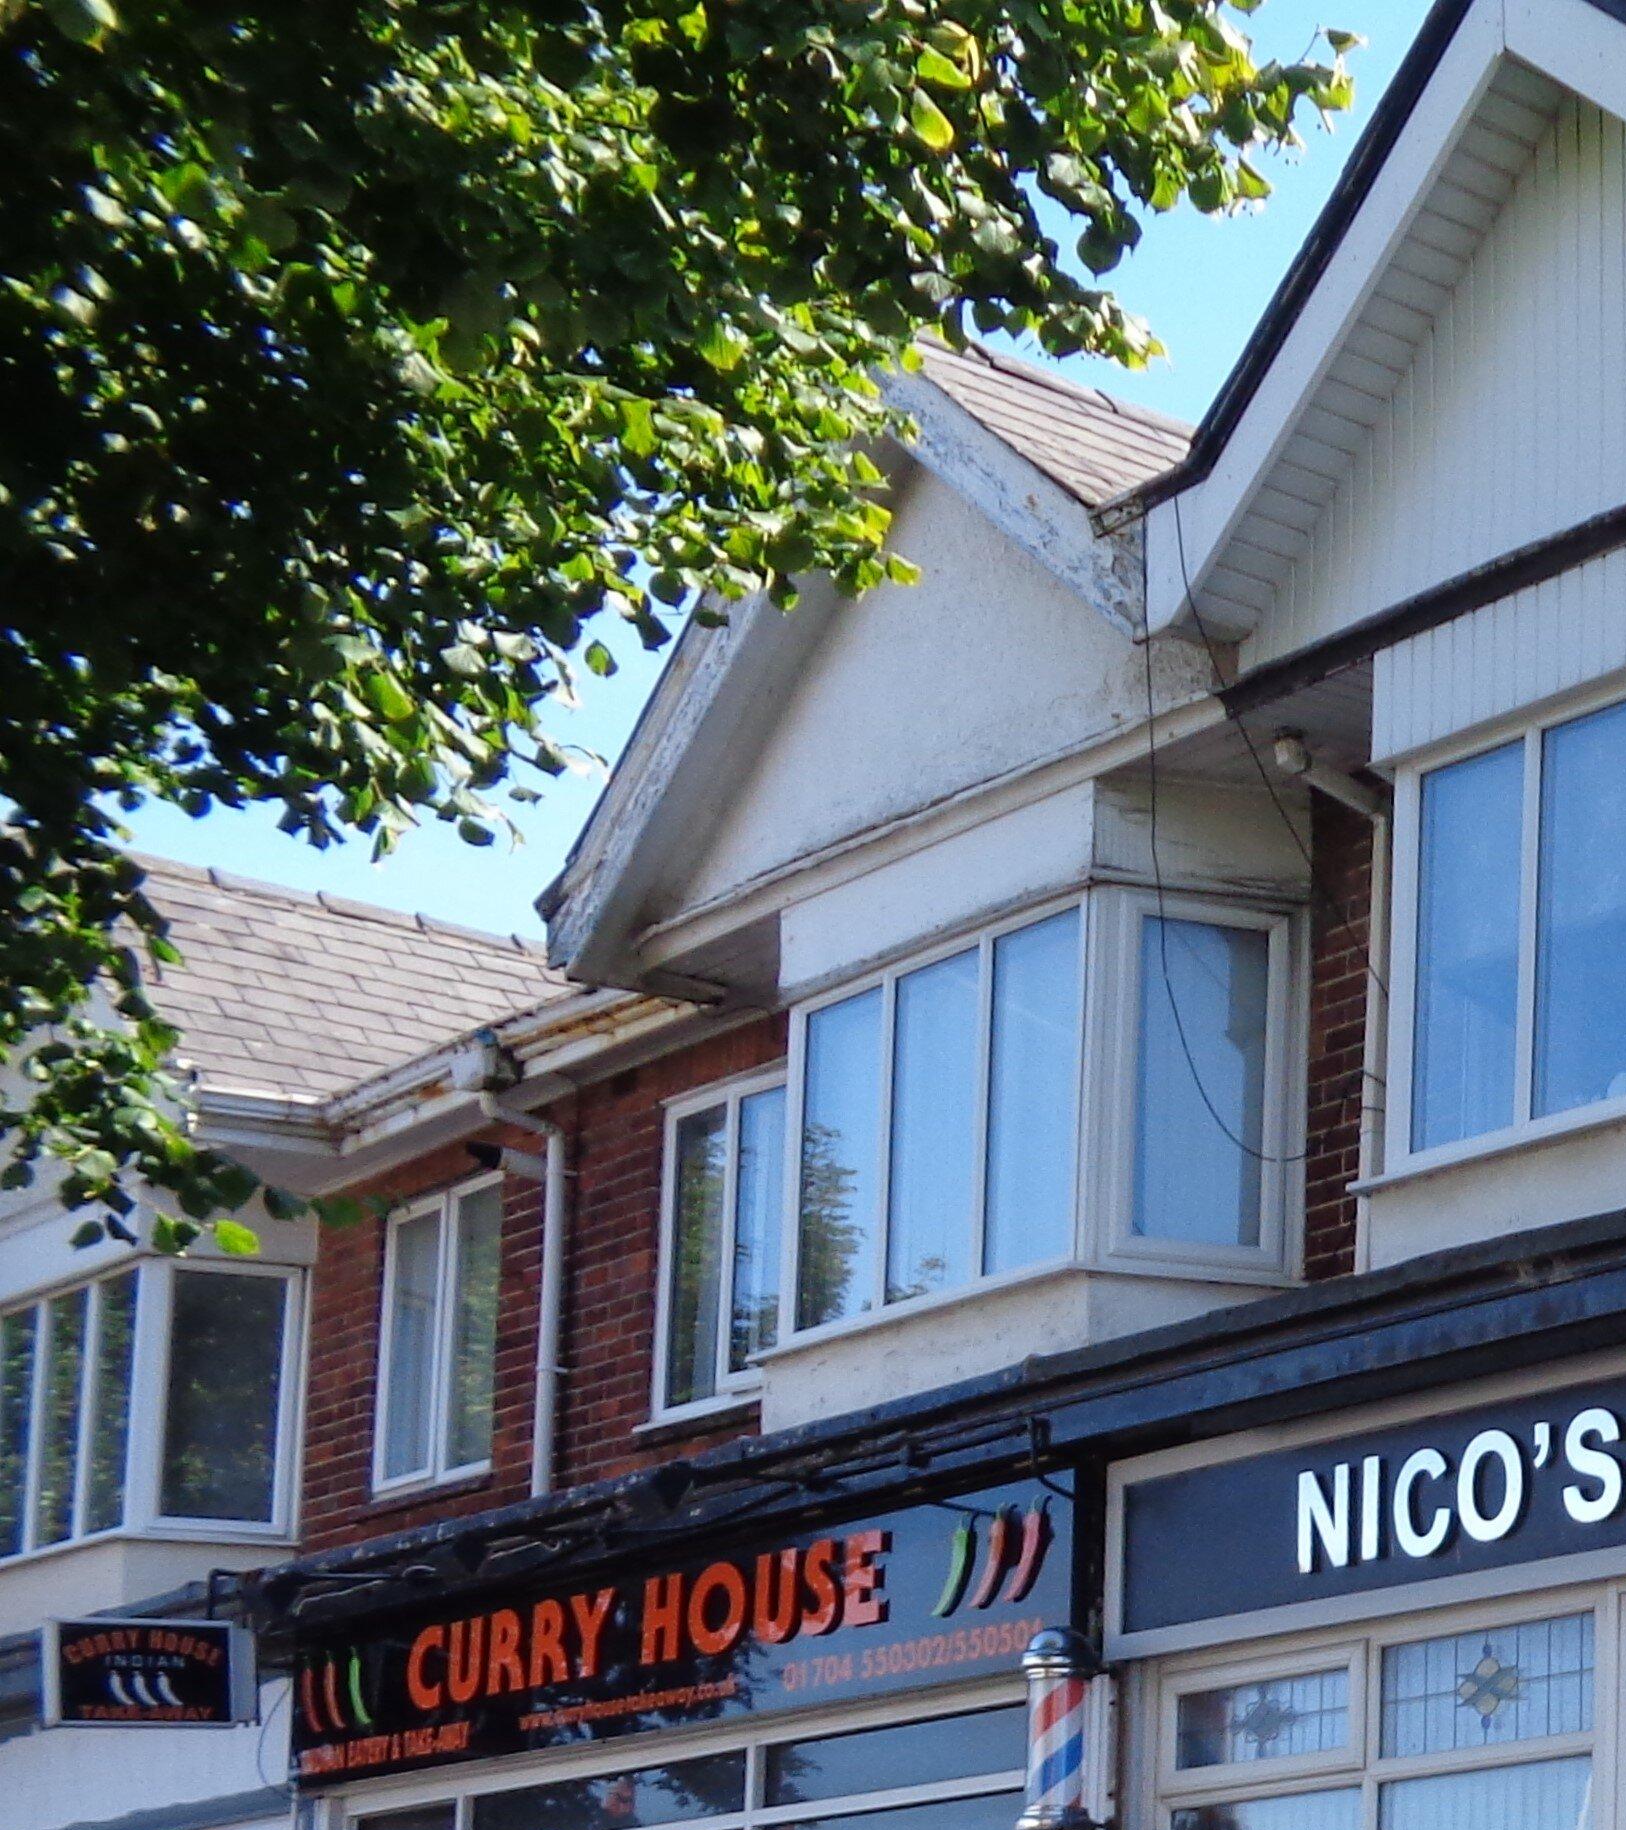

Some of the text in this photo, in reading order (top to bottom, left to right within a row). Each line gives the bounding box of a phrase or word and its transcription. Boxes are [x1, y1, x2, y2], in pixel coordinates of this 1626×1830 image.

[1296, 1405, 1625, 1575] NICO'S
[63, 1630, 221, 1667] CURRY HOUSE
[105, 1654, 186, 1669] INDIAN
[406, 1529, 892, 1711] CURRY HOUSE
